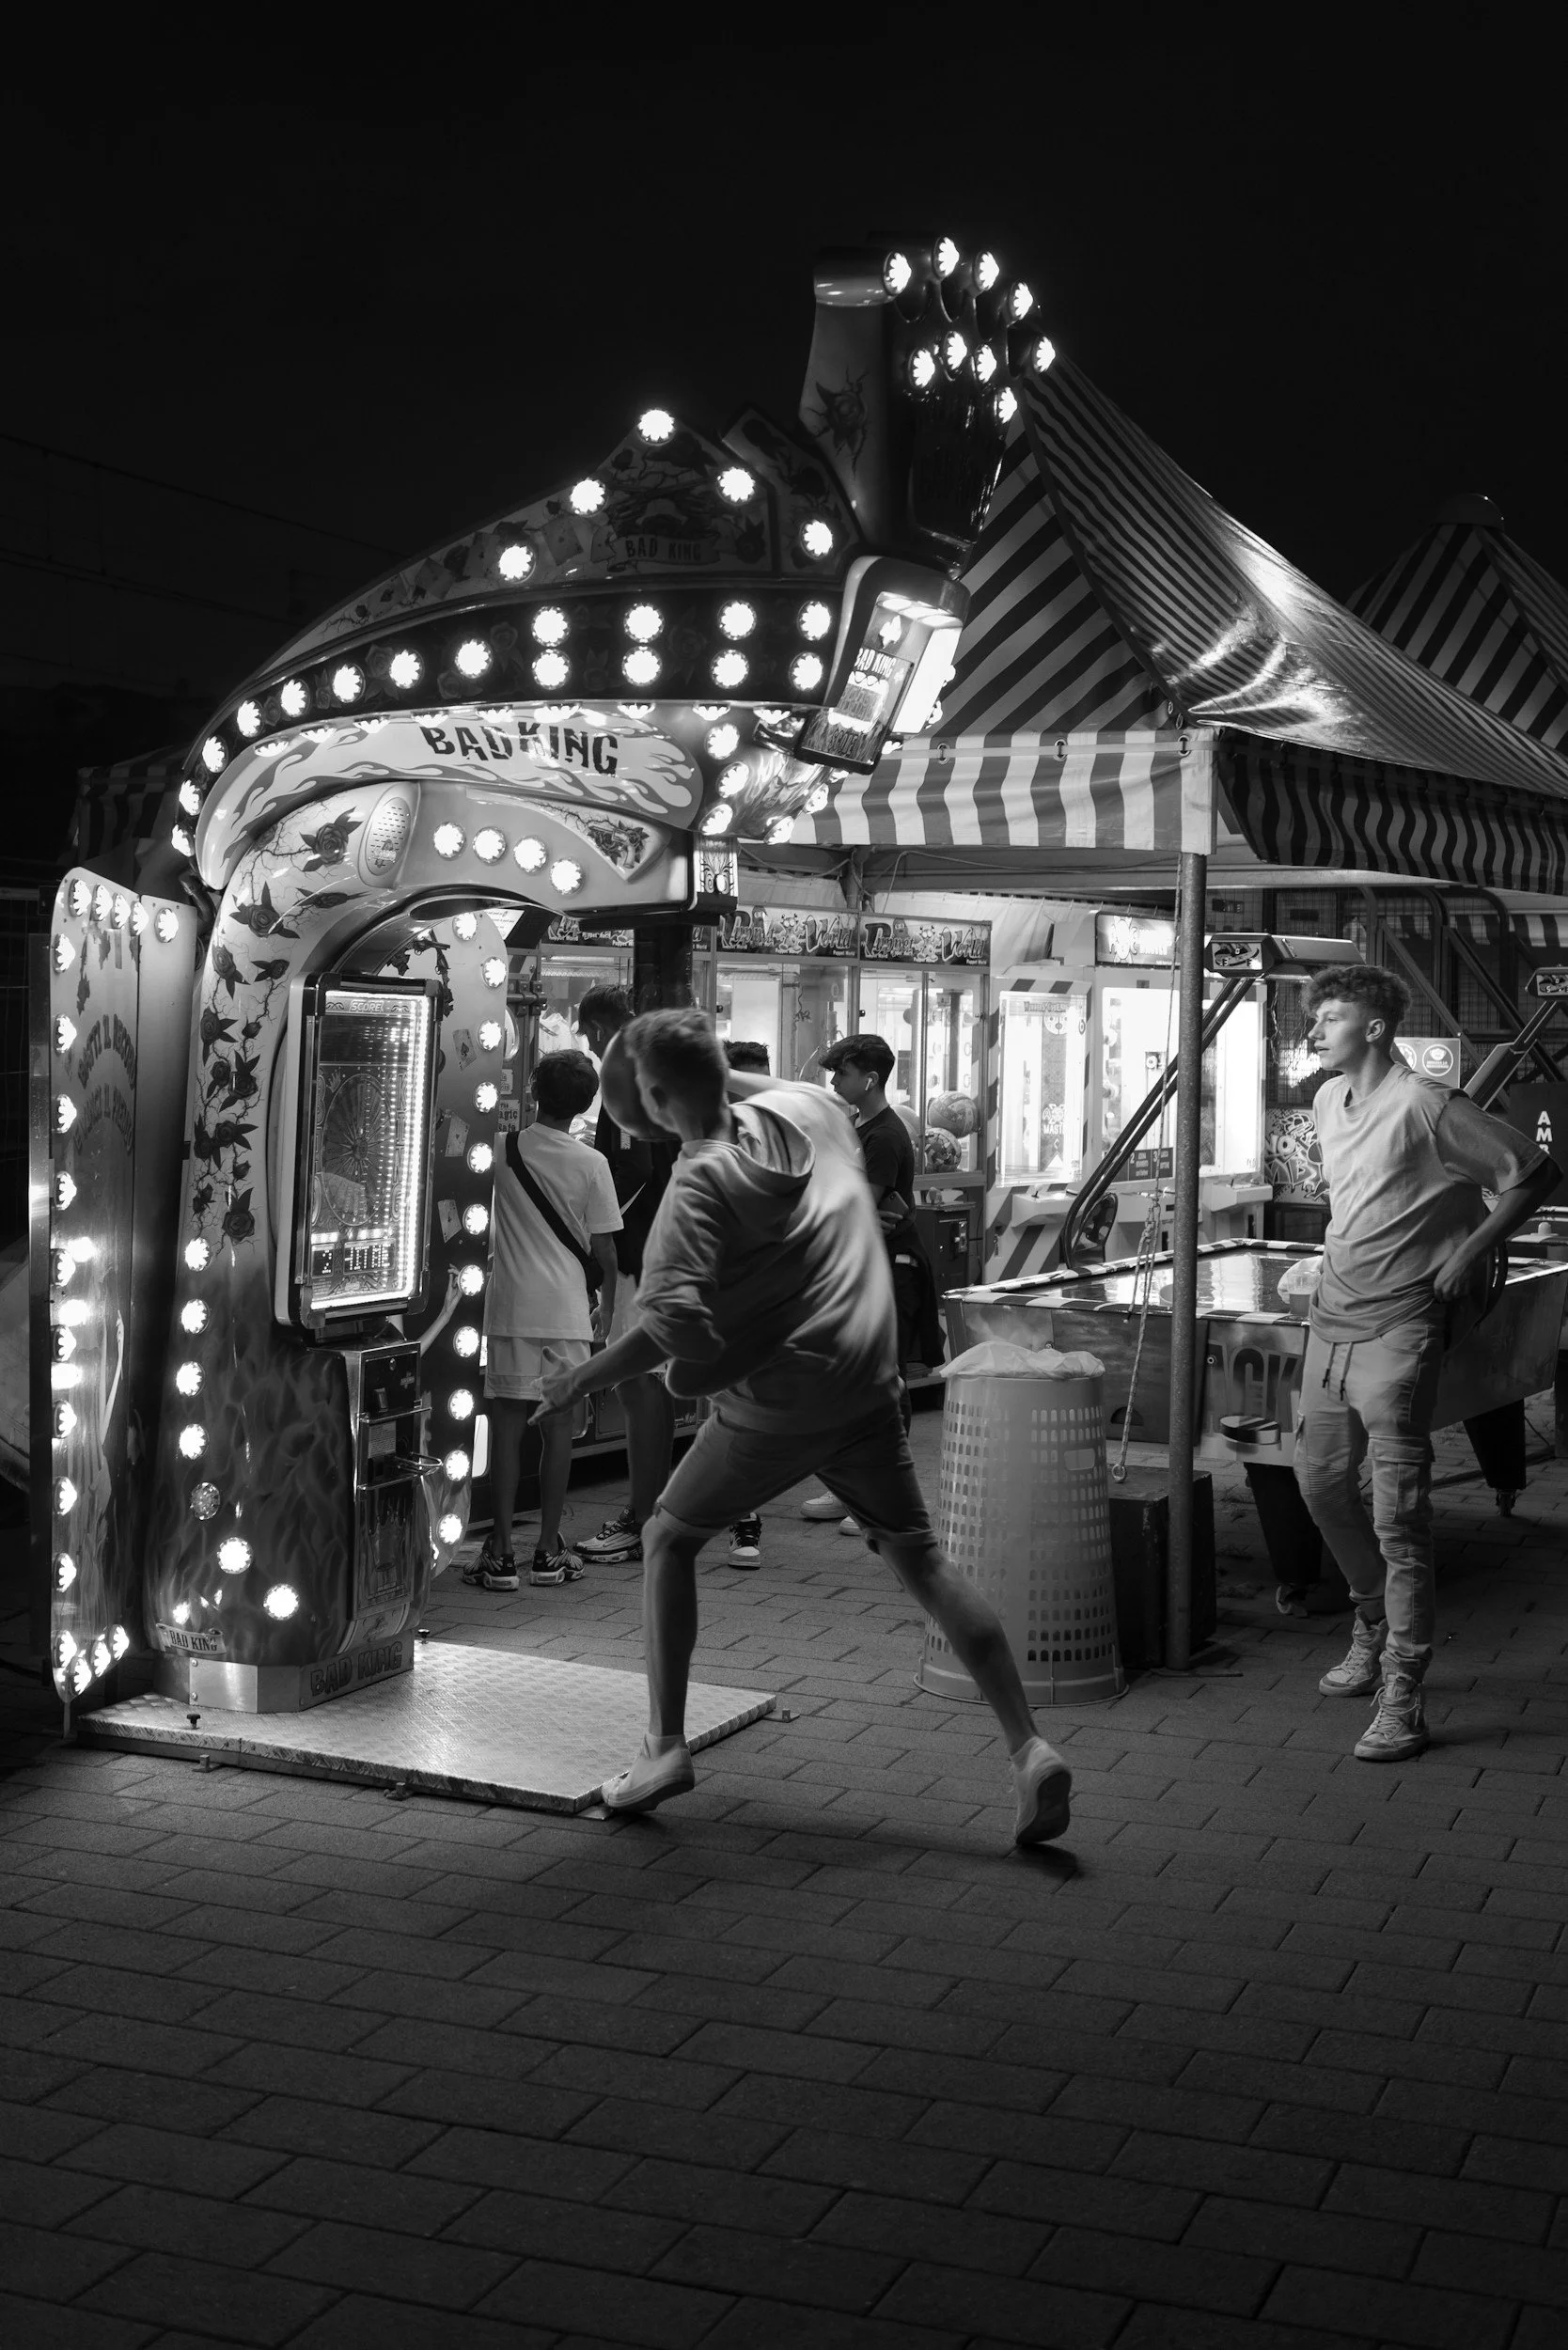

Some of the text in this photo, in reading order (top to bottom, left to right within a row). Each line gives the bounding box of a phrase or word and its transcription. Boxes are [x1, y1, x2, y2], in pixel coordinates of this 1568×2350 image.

[625, 537, 701, 561] BAD KING
[419, 721, 619, 777] BAD KING
[350, 1000, 384, 1013] SCORE
[499, 1109, 518, 1120] agic
[169, 1628, 218, 1653] BAD KING
[310, 1640, 403, 1697] BAD KING
